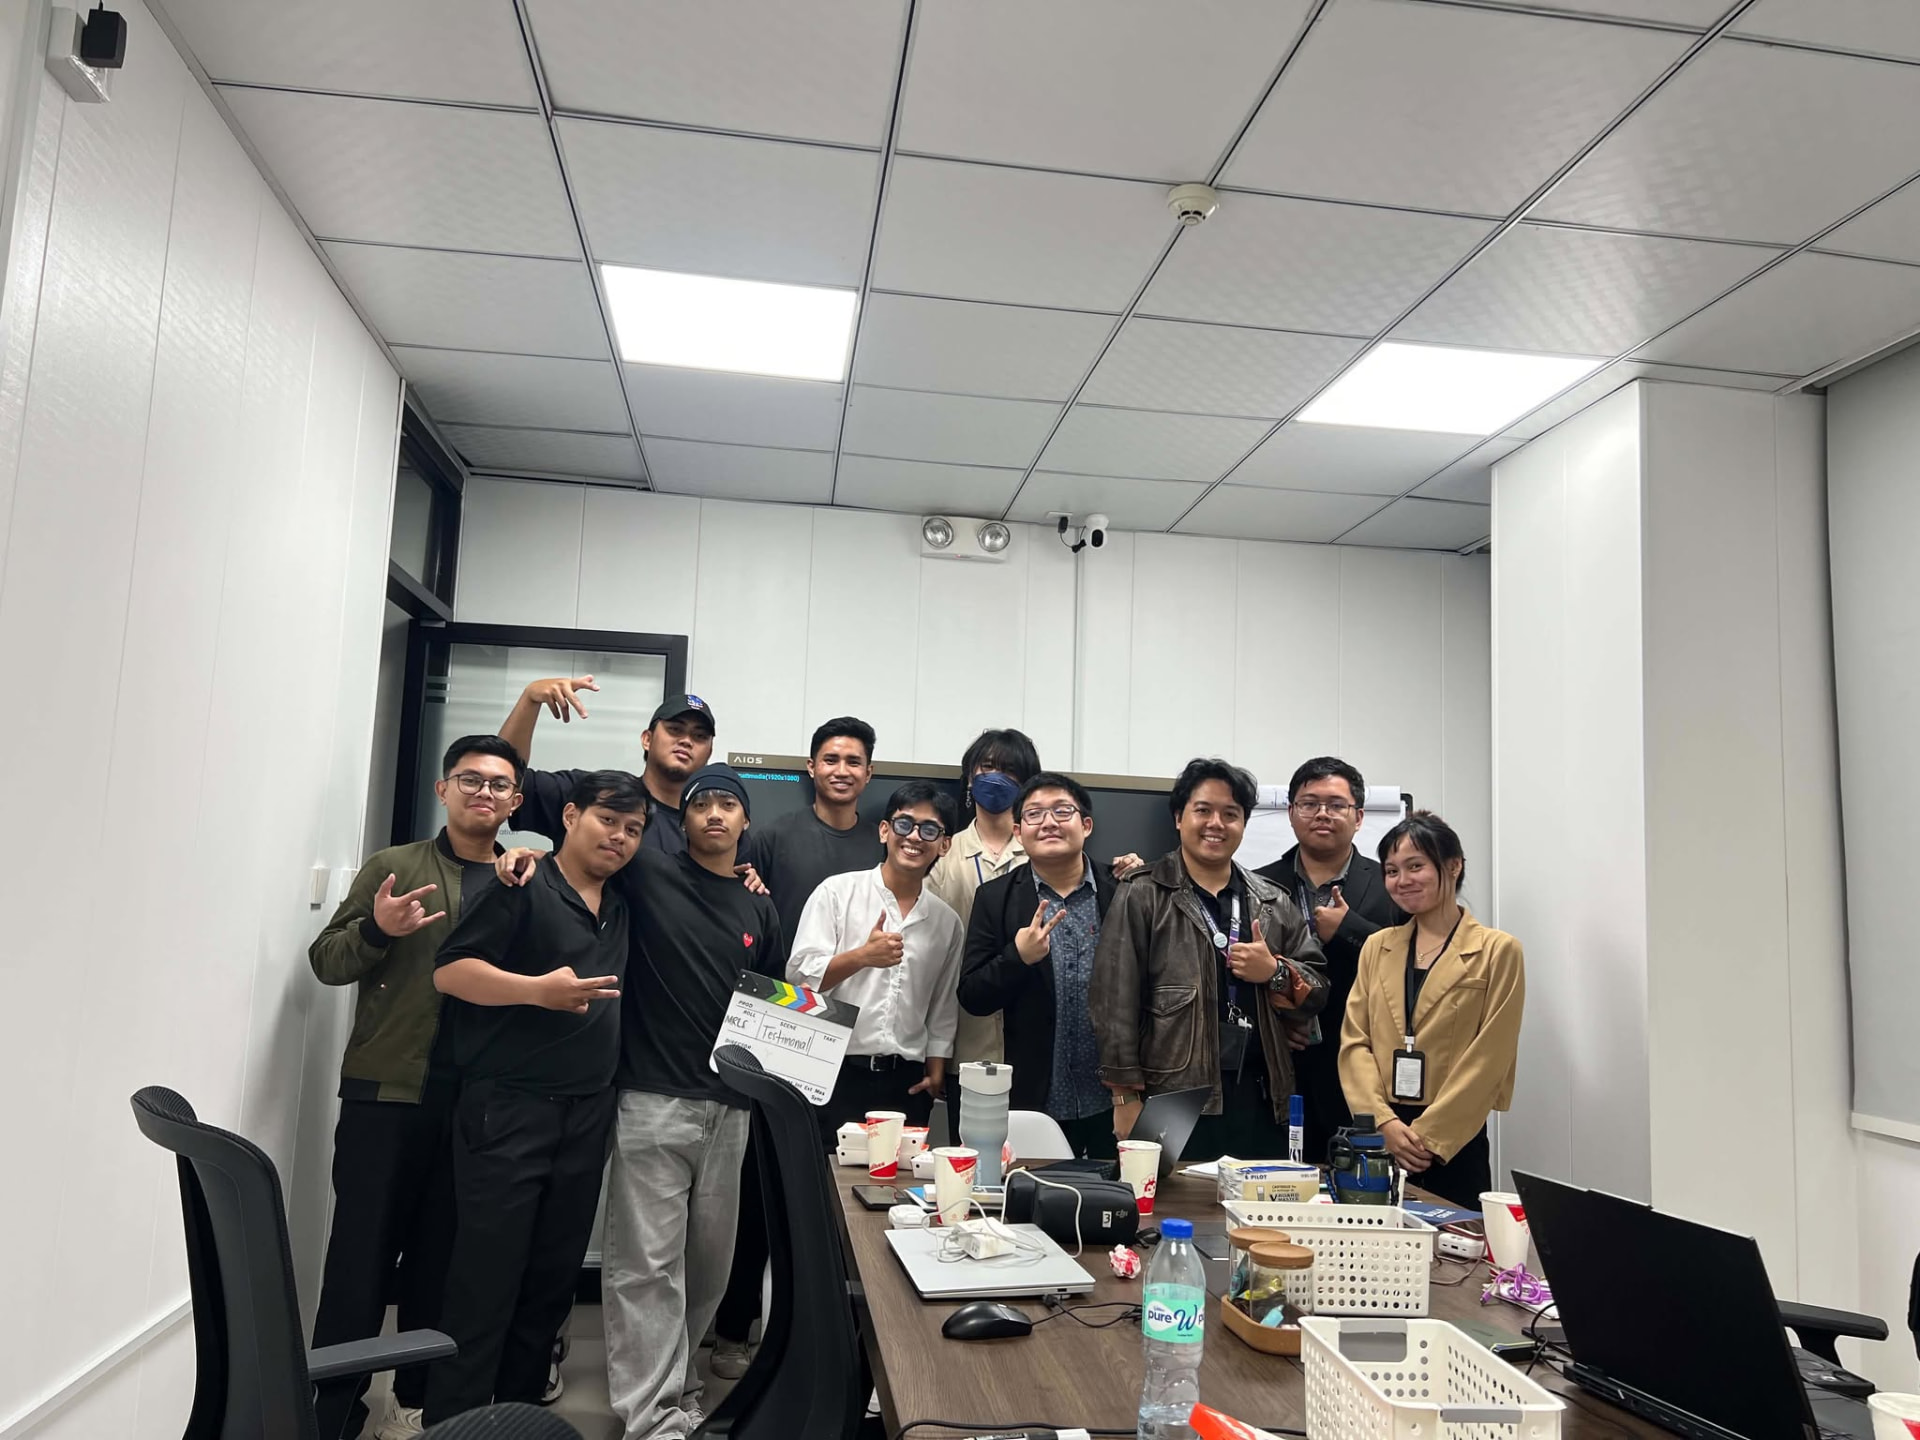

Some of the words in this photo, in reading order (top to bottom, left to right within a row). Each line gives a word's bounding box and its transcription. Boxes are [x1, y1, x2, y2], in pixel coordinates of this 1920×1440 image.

[738, 1000, 753, 1008] PROD
[743, 1010, 756, 1018] ROLL
[780, 1022, 797, 1030] SCENE
[823, 1035, 837, 1043] TAKE
[1103, 1213, 1111, 1224] 3
[1147, 1310, 1172, 1324] pure
